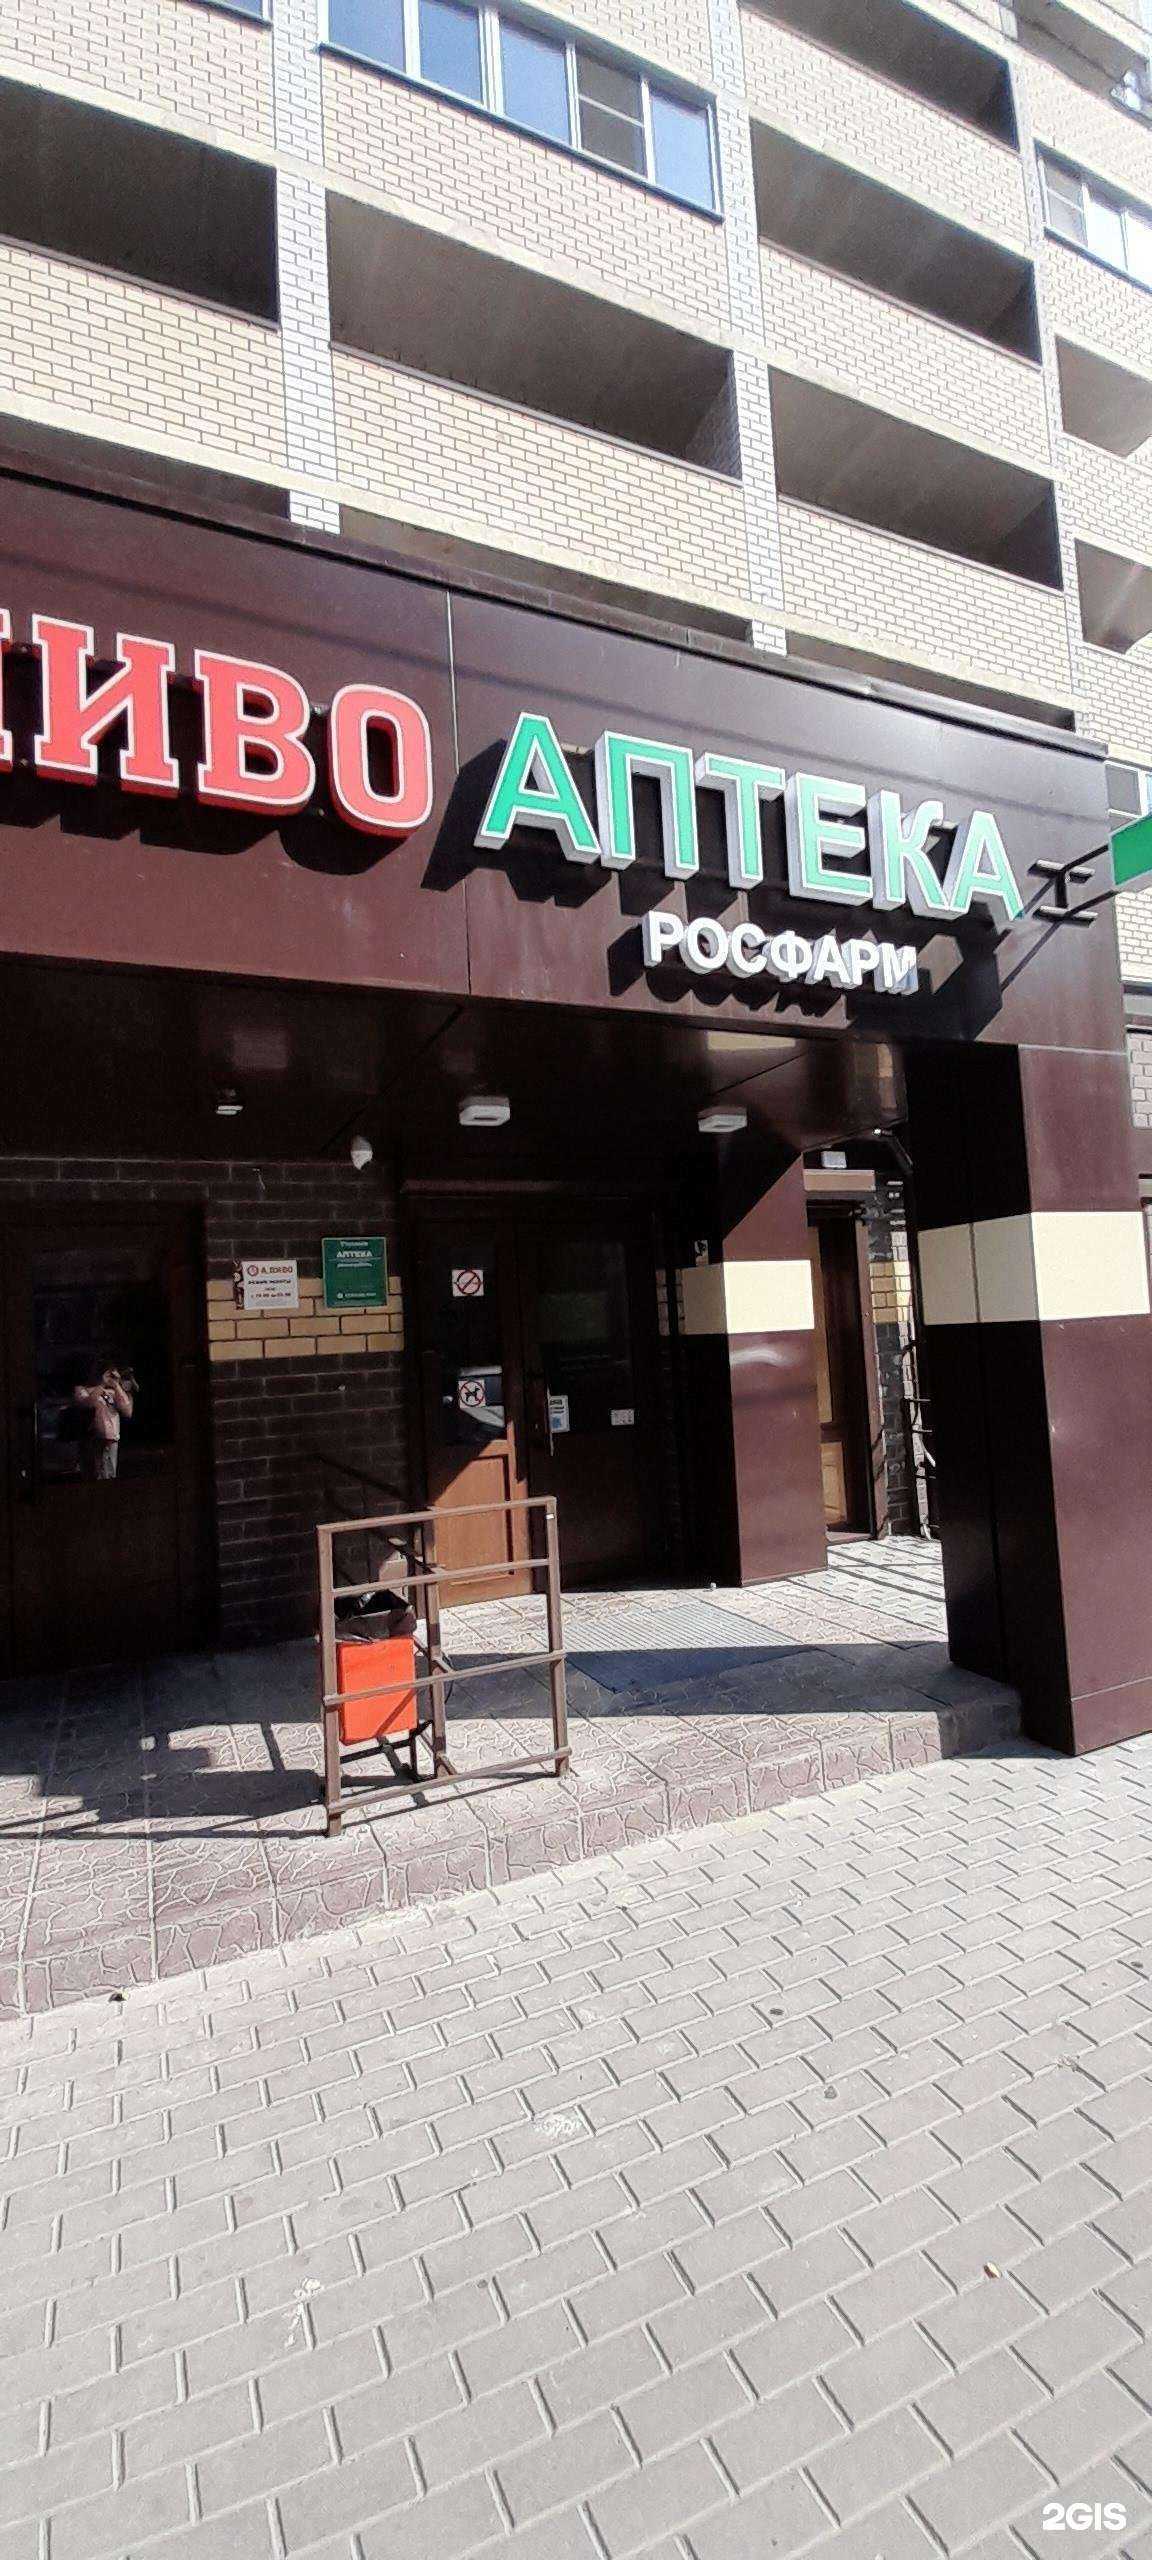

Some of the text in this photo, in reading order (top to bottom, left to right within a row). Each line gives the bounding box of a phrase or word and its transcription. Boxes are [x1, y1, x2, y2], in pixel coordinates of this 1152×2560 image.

[0, 608, 434, 836] ИВО
[475, 712, 1024, 920] АПТЕКА
[643, 910, 917, 994] РОСФАРМ
